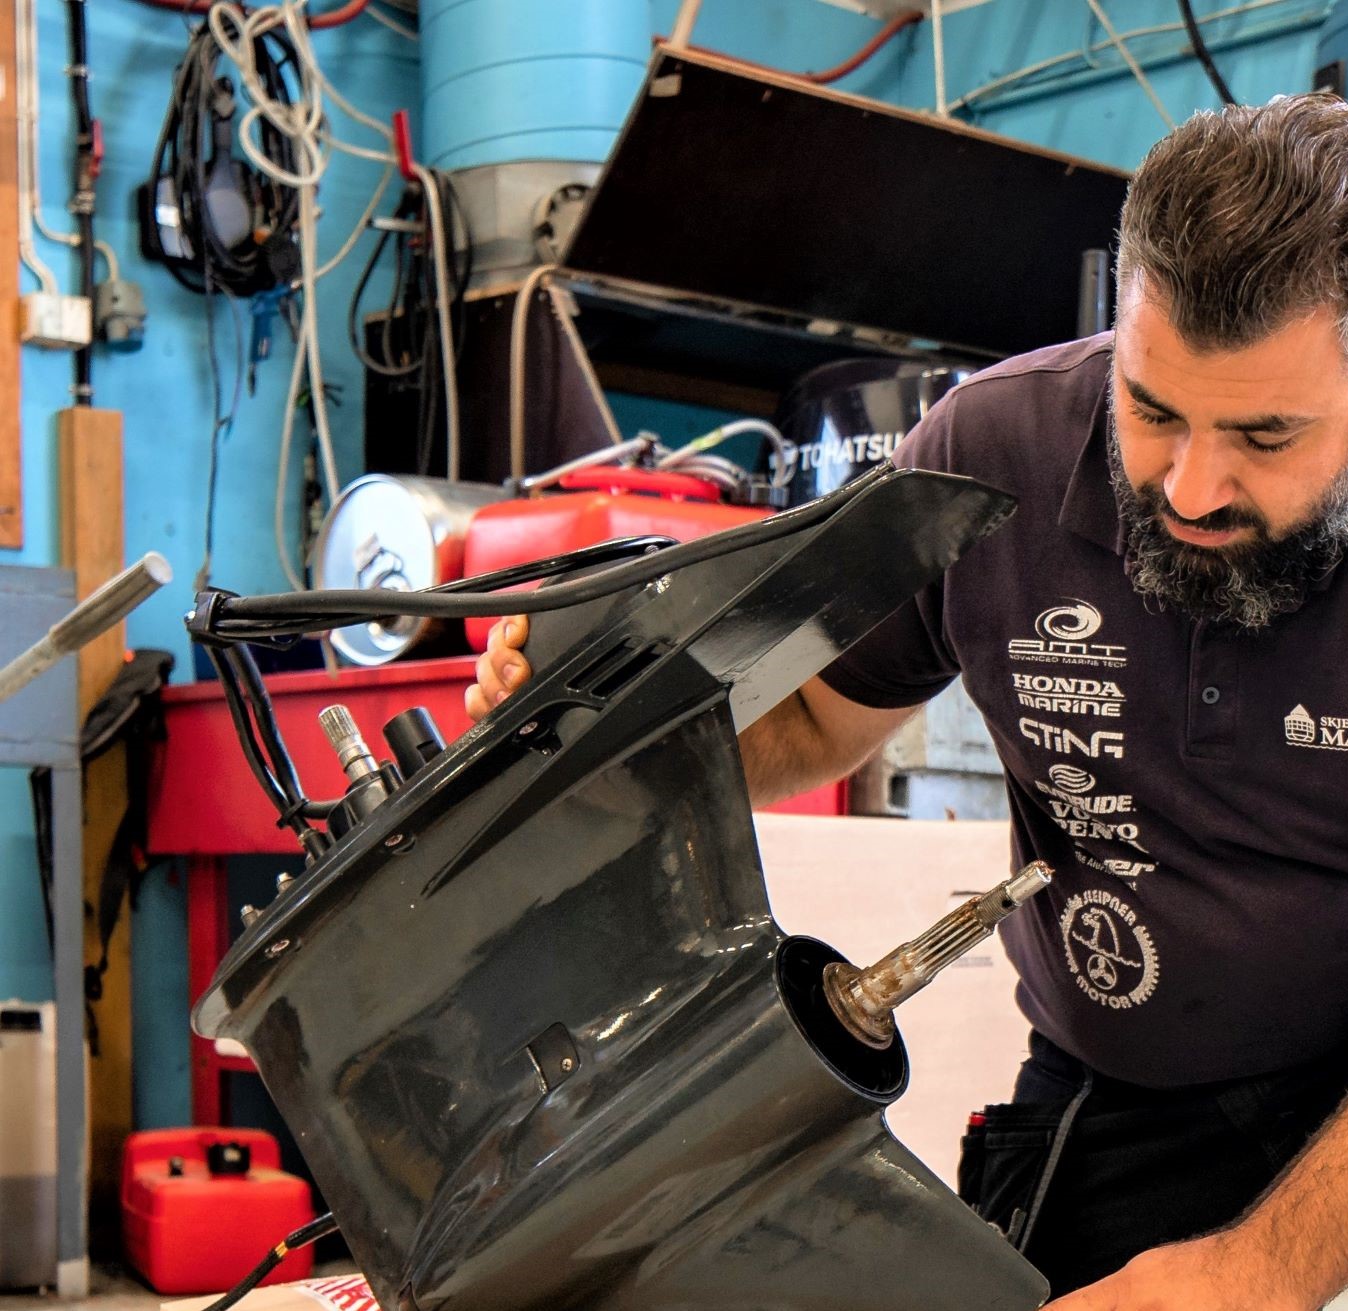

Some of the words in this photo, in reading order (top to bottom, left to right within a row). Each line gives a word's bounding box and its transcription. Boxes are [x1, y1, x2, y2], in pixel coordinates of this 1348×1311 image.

[800, 431, 904, 471] TOHATSU
[1062, 657, 1100, 667] MARINE
[1012, 673, 1125, 698] HONDA
[1018, 693, 1121, 717] MARINE
[1076, 975, 1132, 1009] MOTOR
